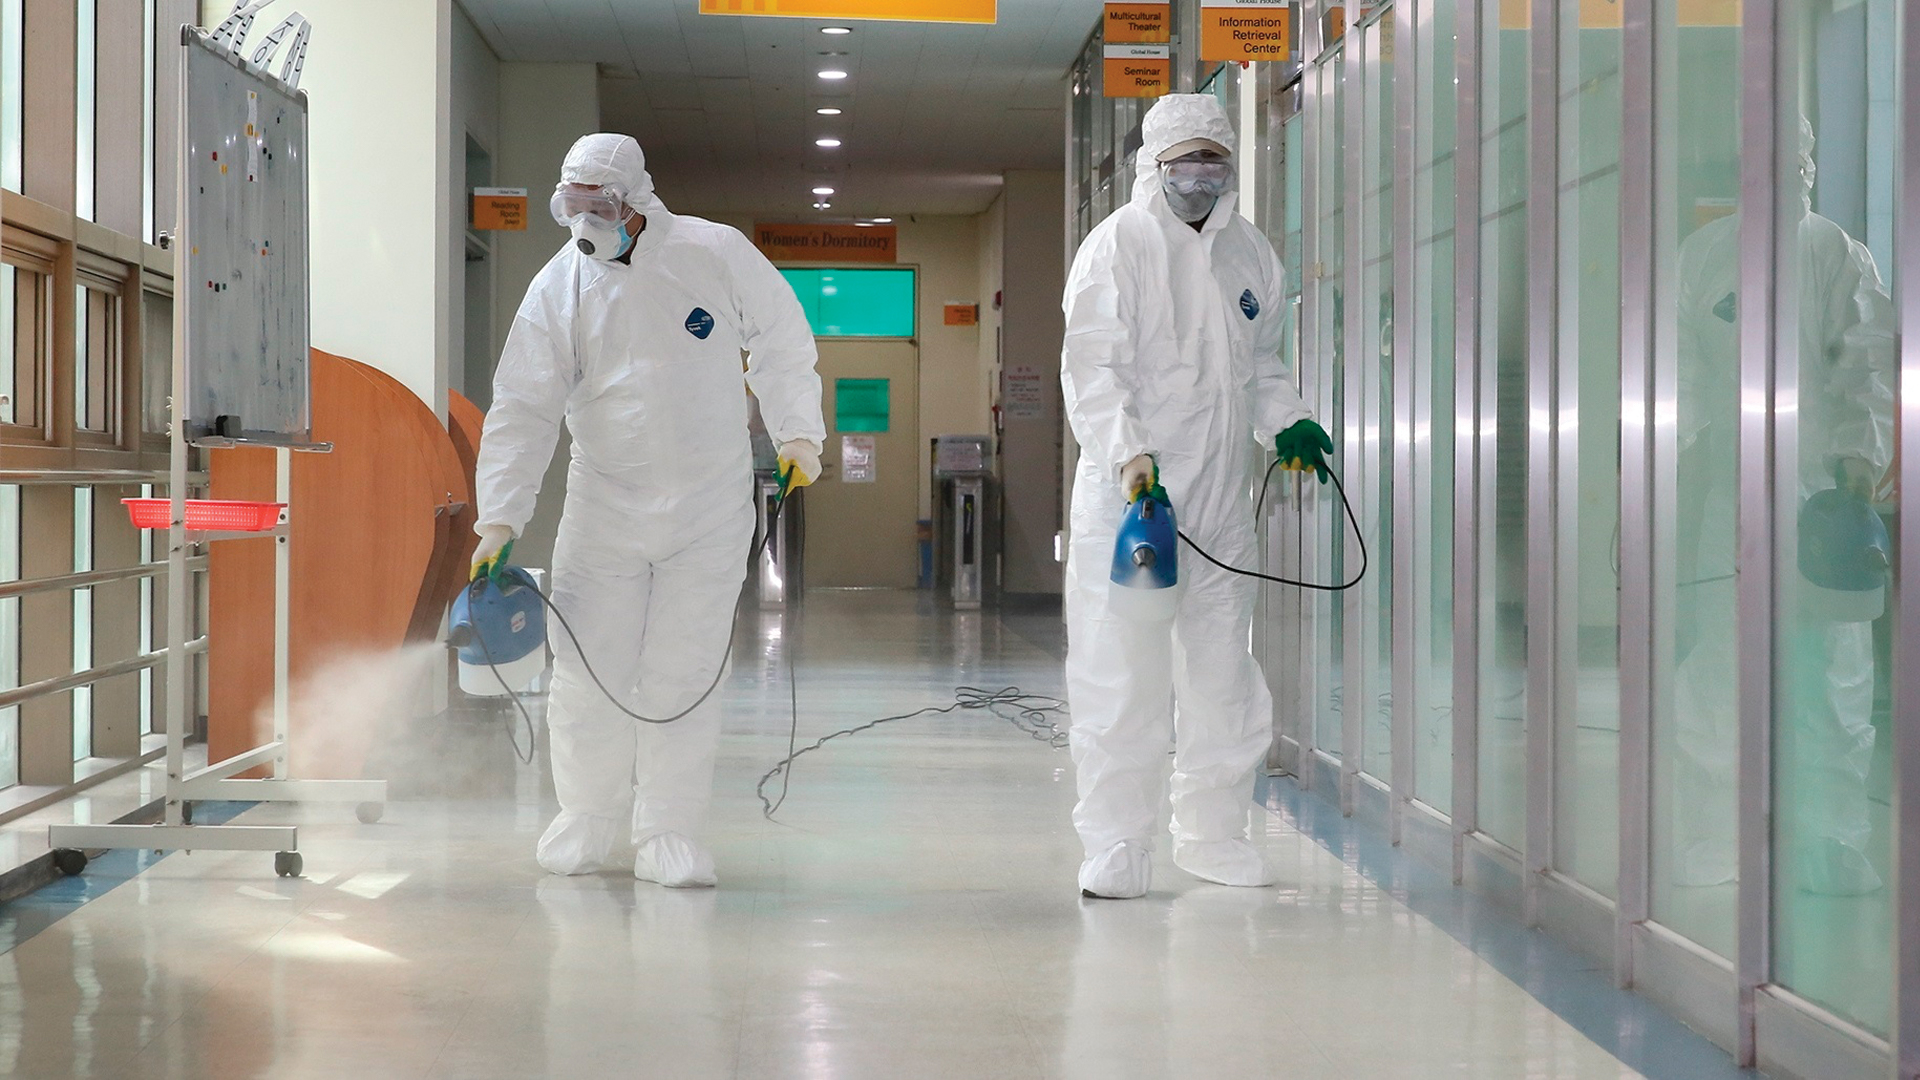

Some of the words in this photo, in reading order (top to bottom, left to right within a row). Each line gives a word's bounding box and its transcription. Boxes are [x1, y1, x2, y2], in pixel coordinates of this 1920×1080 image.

[1110, 12, 1161, 20] Multicultural
[1128, 22, 1161, 31] Theater
[1219, 17, 1281, 27] Information
[1233, 30, 1281, 40] Retrieval
[1243, 43, 1281, 53] Center
[1124, 66, 1161, 75] Seminar
[1135, 78, 1160, 86] Room
[491, 201, 520, 210] Reading
[500, 210, 520, 218] Room
[761, 231, 819, 247] Women's
[822, 232, 889, 251] Dormitory
